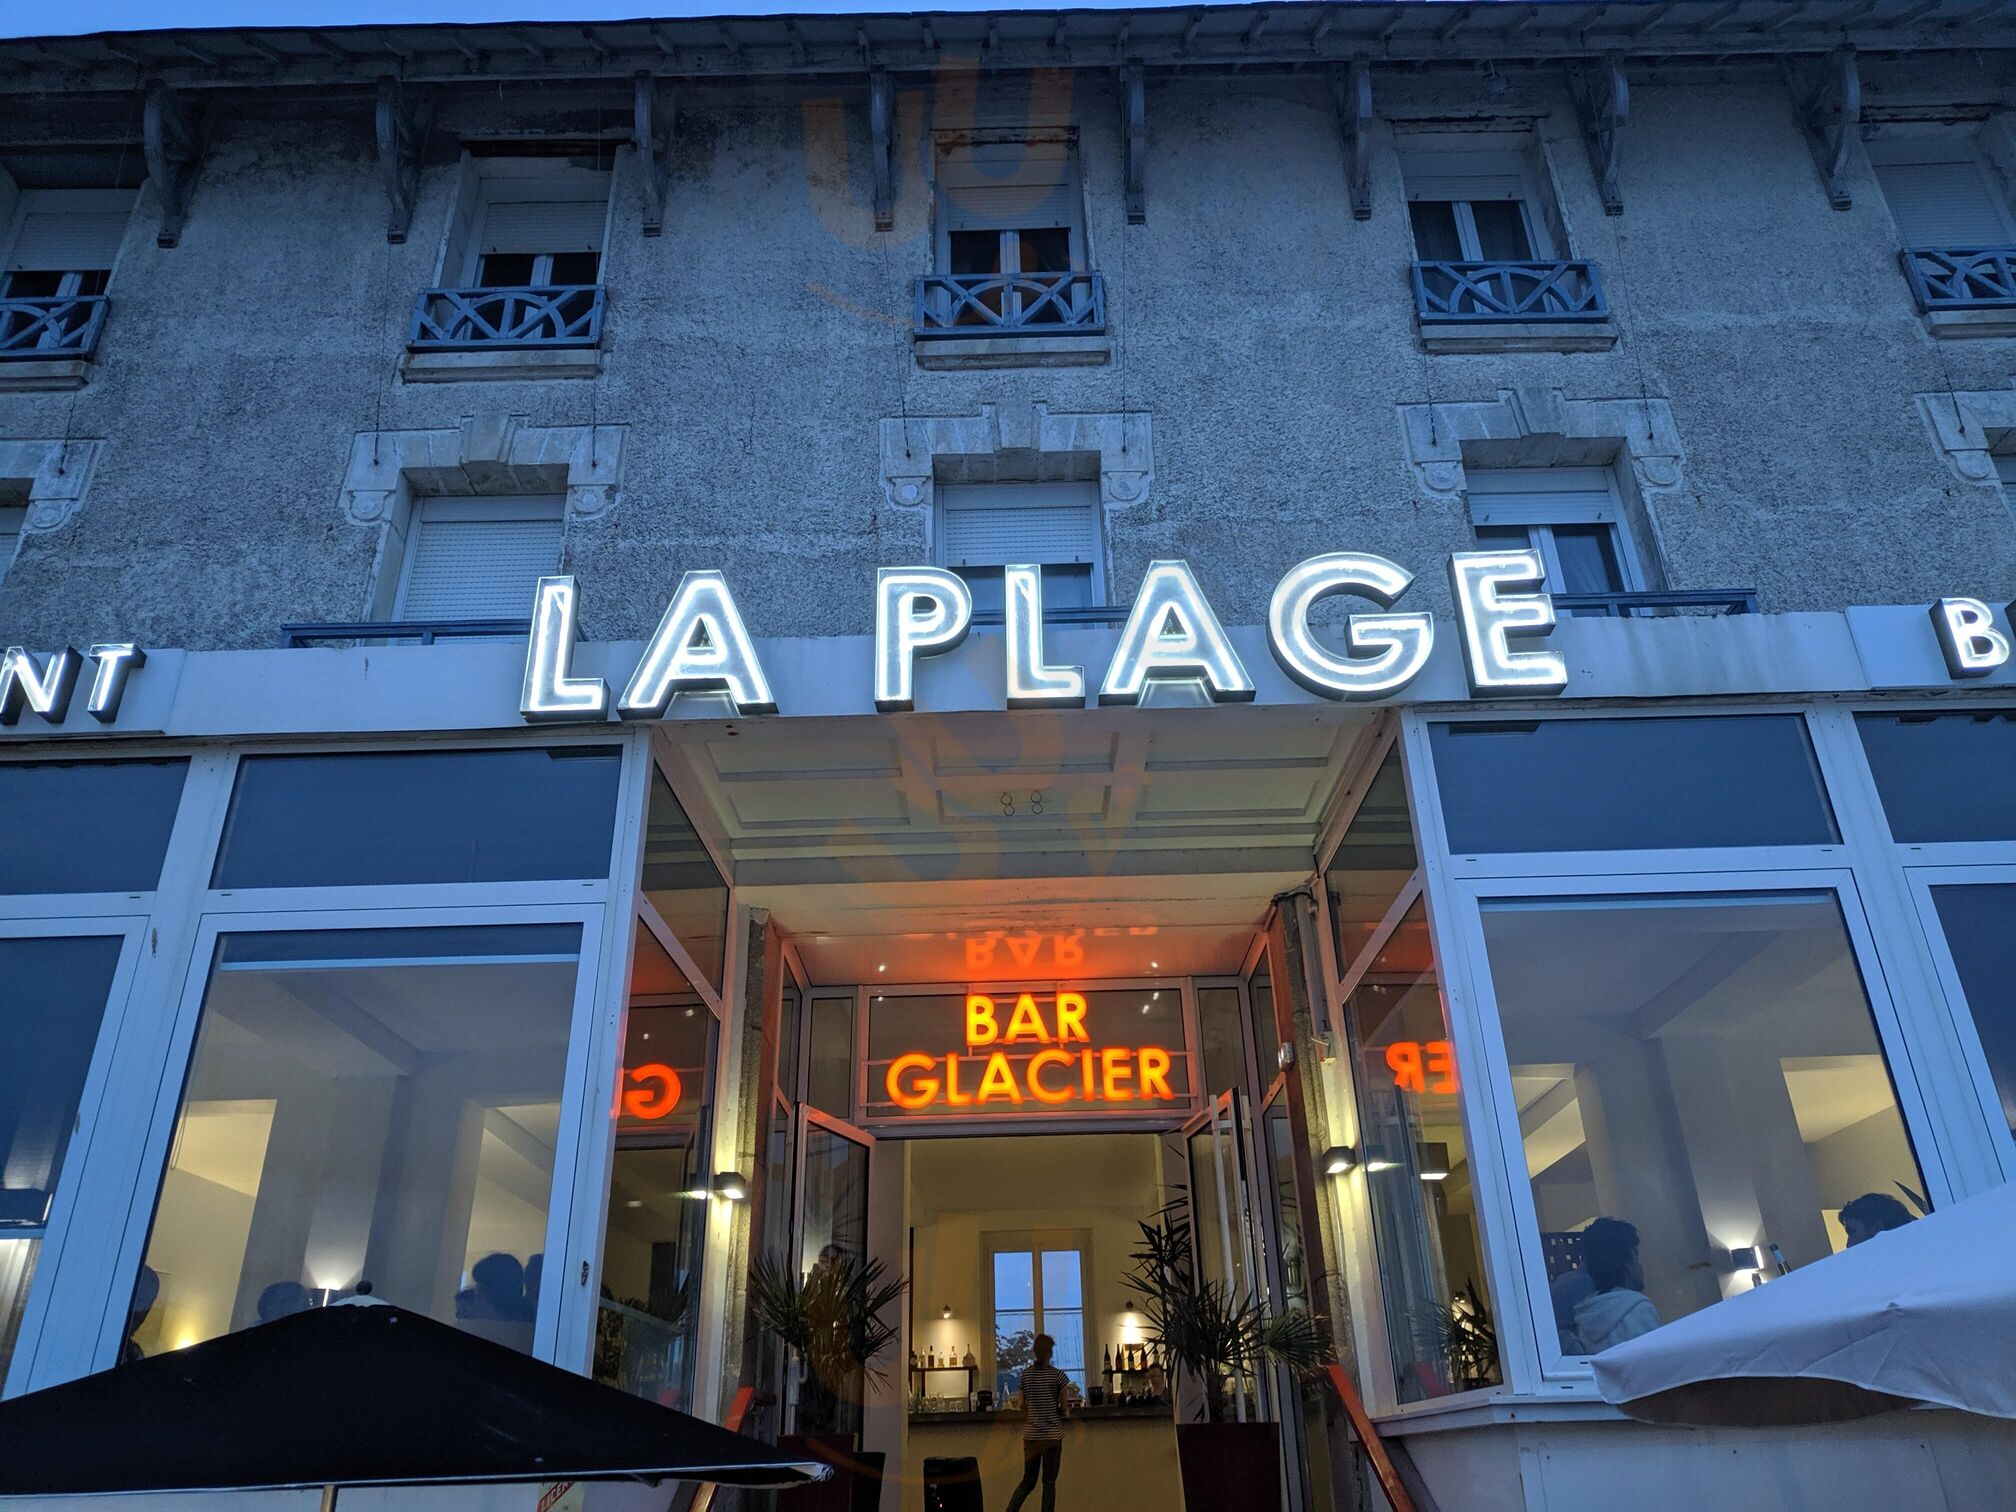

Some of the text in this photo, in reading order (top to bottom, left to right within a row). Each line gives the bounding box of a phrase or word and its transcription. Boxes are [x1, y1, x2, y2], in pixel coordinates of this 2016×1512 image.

[520, 549, 1568, 721] LA PLAGE
[965, 992, 1090, 1046] BAR
[886, 1047, 1175, 1109] GLACIER
